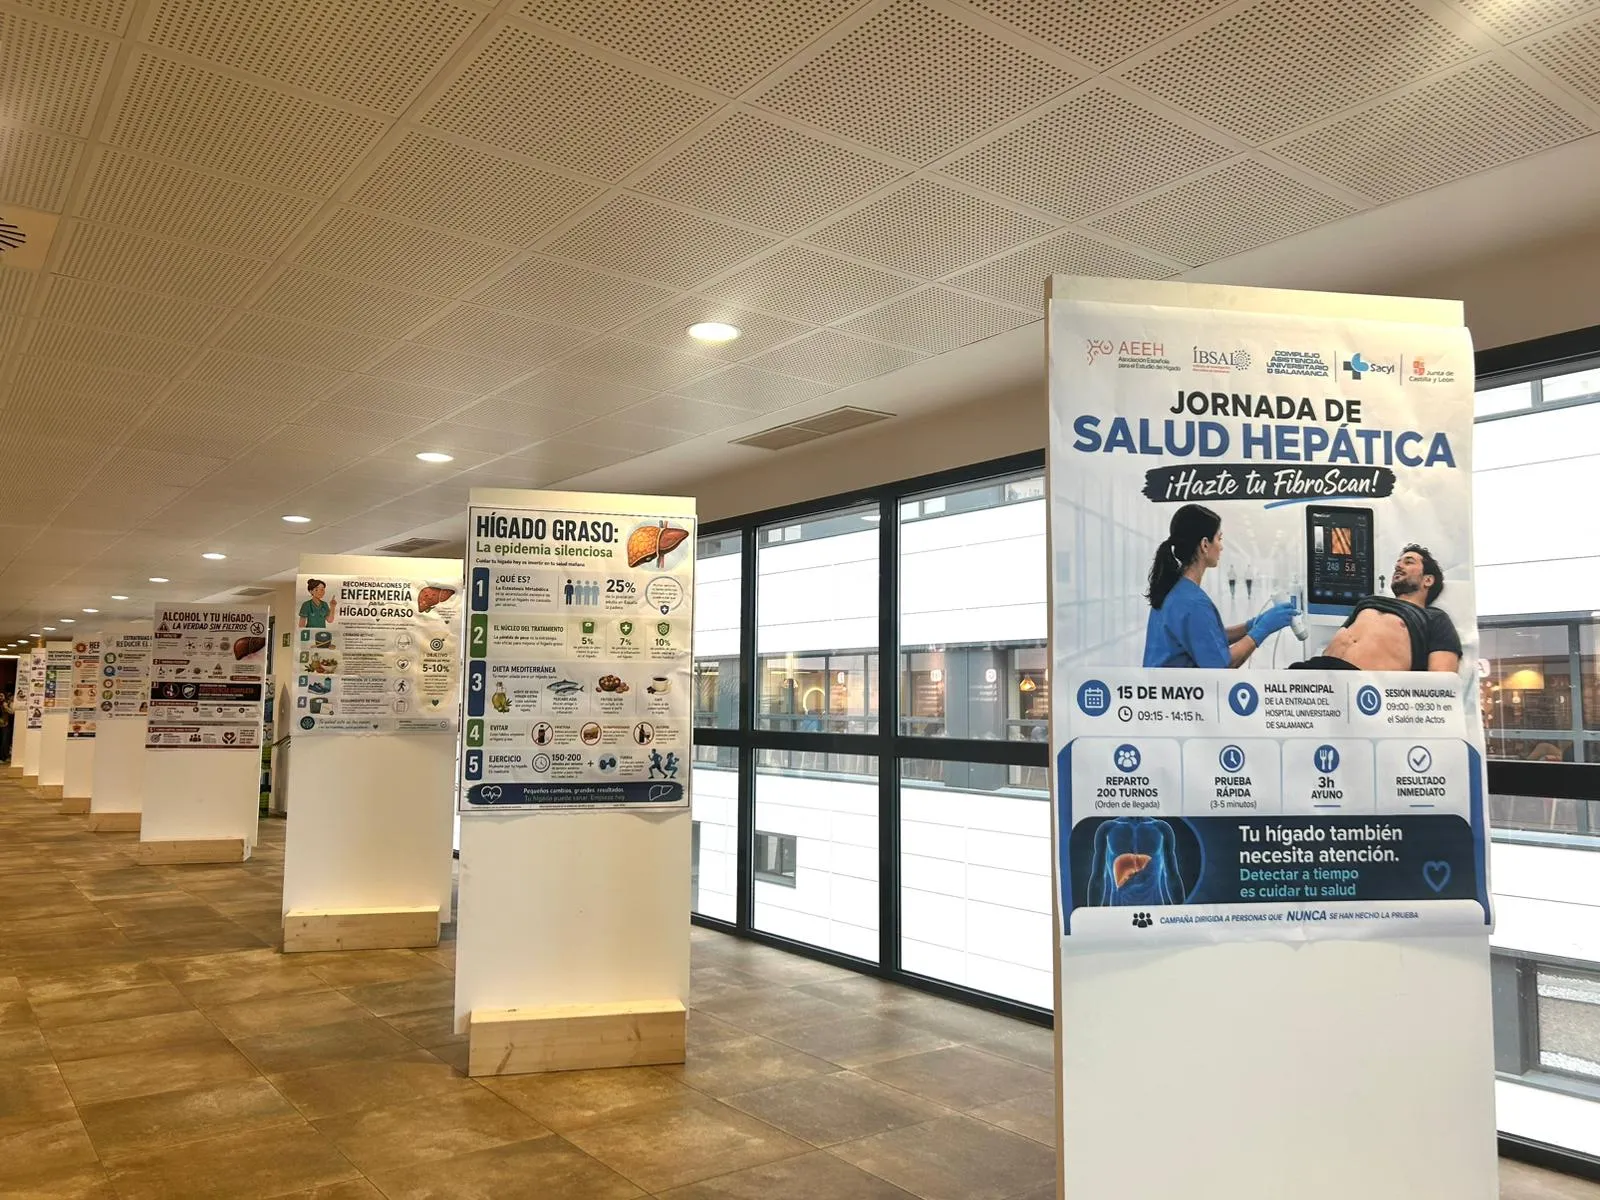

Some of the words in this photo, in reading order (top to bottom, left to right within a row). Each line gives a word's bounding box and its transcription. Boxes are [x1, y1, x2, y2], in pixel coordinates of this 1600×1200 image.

[1118, 341, 1164, 356] AEEH
[1274, 350, 1320, 358] COMPLEJO
[1270, 356, 1324, 365] ASISTENCIAL
[1266, 362, 1328, 371] UNIVERSITARIO
[1370, 364, 1395, 374] Sacyl
[1274, 368, 1328, 377] SALAMANCA
[1170, 391, 1317, 421] JORNADA
[1325, 399, 1362, 424] DE
[1072, 415, 1230, 458] SALUD
[1242, 423, 1456, 468] HEPÁTICA
[1165, 469, 1239, 500] ¡Hazte
[1246, 470, 1267, 495] tu
[1273, 468, 1380, 496] FibroScan!
[476, 512, 546, 540] HÍGADO
[552, 520, 618, 543] GRASO:
[476, 542, 490, 554] La
[494, 542, 551, 556] epidemia
[554, 544, 613, 558] silenciosa
[496, 574, 516, 584] ¿QUÉ
[518, 576, 531, 584] ES?
[476, 579, 484, 598] 1
[606, 579, 636, 593] 25%
[341, 588, 412, 601] ENFERMERÍA
[339, 605, 378, 617] HÍGADO
[380, 608, 414, 618] GRASO
[162, 612, 200, 622] ALCOHOL
[203, 612, 208, 622] Y
[210, 612, 220, 622] TU
[222, 612, 254, 623] HÍGADO:
[474, 627, 484, 644] 2
[582, 637, 594, 646] 5%
[620, 638, 632, 646] 7%
[656, 638, 671, 646] 10%
[422, 664, 450, 672] 5-10%
[510, 666, 556, 674] MEDITERRÁNEA
[472, 673, 482, 691] 3
[1116, 686, 1132, 700] 15
[1137, 686, 1158, 700] DE
[1162, 686, 1204, 700] MAYO
[1264, 684, 1287, 693] HALL
[1289, 684, 1334, 694] PRINCIPAL
[1286, 698, 1316, 706] ENTRADA
[1386, 702, 1409, 711] 09:00
[1414, 703, 1436, 711] 09:30
[1436, 703, 1442, 711] h
[1138, 710, 1164, 721] 09:15
[1172, 710, 1194, 721] 14:15
[1195, 711, 1204, 722] h.
[1265, 709, 1296, 717] HOSPITAL
[1296, 710, 1341, 718] UNIVERSITARIO
[1388, 716, 1394, 724] el
[1394, 715, 1414, 724] Salón
[1425, 716, 1445, 724] Actos
[470, 724, 480, 741] 4
[488, 755, 522, 763] EJERCICIO
[552, 754, 582, 762] 150-200
[468, 755, 478, 773] 5
[1106, 776, 1150, 786] REPARTO
[1214, 776, 1252, 786] PRUEBA
[1318, 776, 1334, 788] 3h
[1396, 776, 1446, 785] RESULTADO
[1097, 788, 1116, 797] 200
[1120, 788, 1158, 797] TURNOS
[1216, 787, 1251, 798] RÁPIDA
[1311, 790, 1343, 799] AYUNO
[1397, 788, 1446, 797] INMEDIATO
[1094, 800, 1122, 810] (Orden
[1132, 800, 1160, 810] llegada)
[1210, 800, 1225, 810] (3-5
[1226, 800, 1257, 810] minutos)
[1238, 825, 1260, 842] Tu
[1266, 824, 1326, 846] hígado
[1330, 824, 1403, 841] también
[1240, 846, 1314, 864] necesita
[1319, 845, 1400, 862] atención.
[1240, 868, 1298, 881] Detectar
[1302, 871, 1310, 880] a
[1313, 867, 1358, 882] tiempo
[1240, 888, 1256, 898] es
[1259, 884, 1300, 898] cuidar
[1304, 885, 1317, 897] tu
[1321, 884, 1356, 896] salud
[1160, 914, 1194, 924] CAMPAÑA
[1195, 914, 1224, 923] DIRIGIDA
[1232, 914, 1267, 922] PERSONAS
[1268, 914, 1282, 922] QUE
[1286, 910, 1327, 921] NUNCA
[1339, 912, 1354, 920] HAN
[1354, 911, 1380, 919] HECHO
[1391, 911, 1419, 919] PRUEBA
